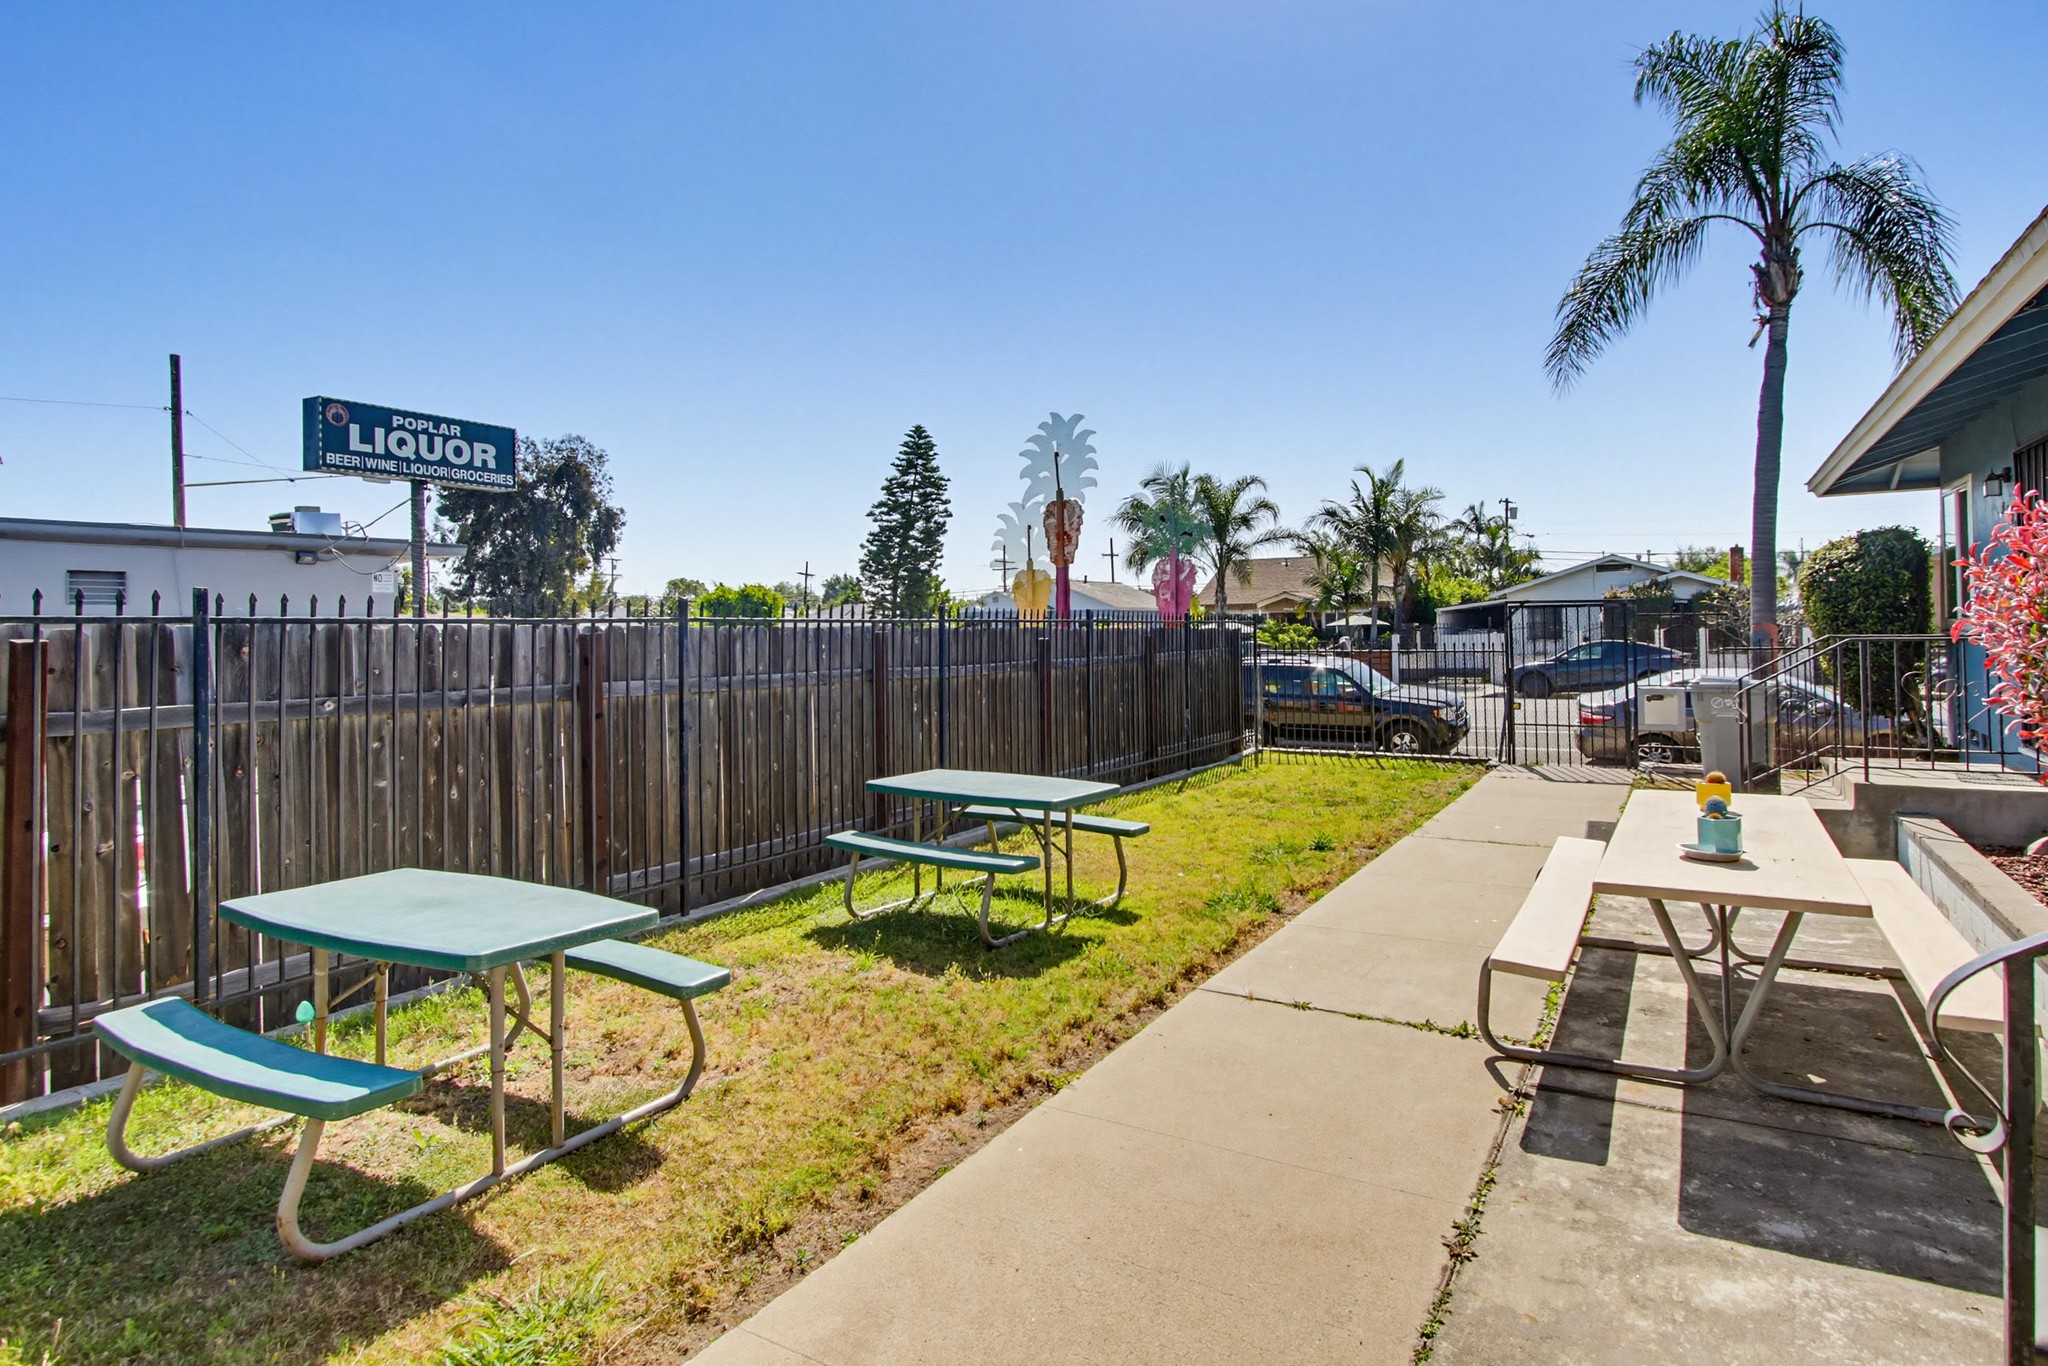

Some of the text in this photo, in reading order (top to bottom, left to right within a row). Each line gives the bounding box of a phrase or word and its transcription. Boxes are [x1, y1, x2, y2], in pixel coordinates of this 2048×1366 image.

[392, 415, 461, 437] POPLAR
[349, 423, 497, 469] LIQUOR
[326, 453, 514, 486] BEER WINE LIQUOR GROCERIES
[373, 573, 383, 583] NO
